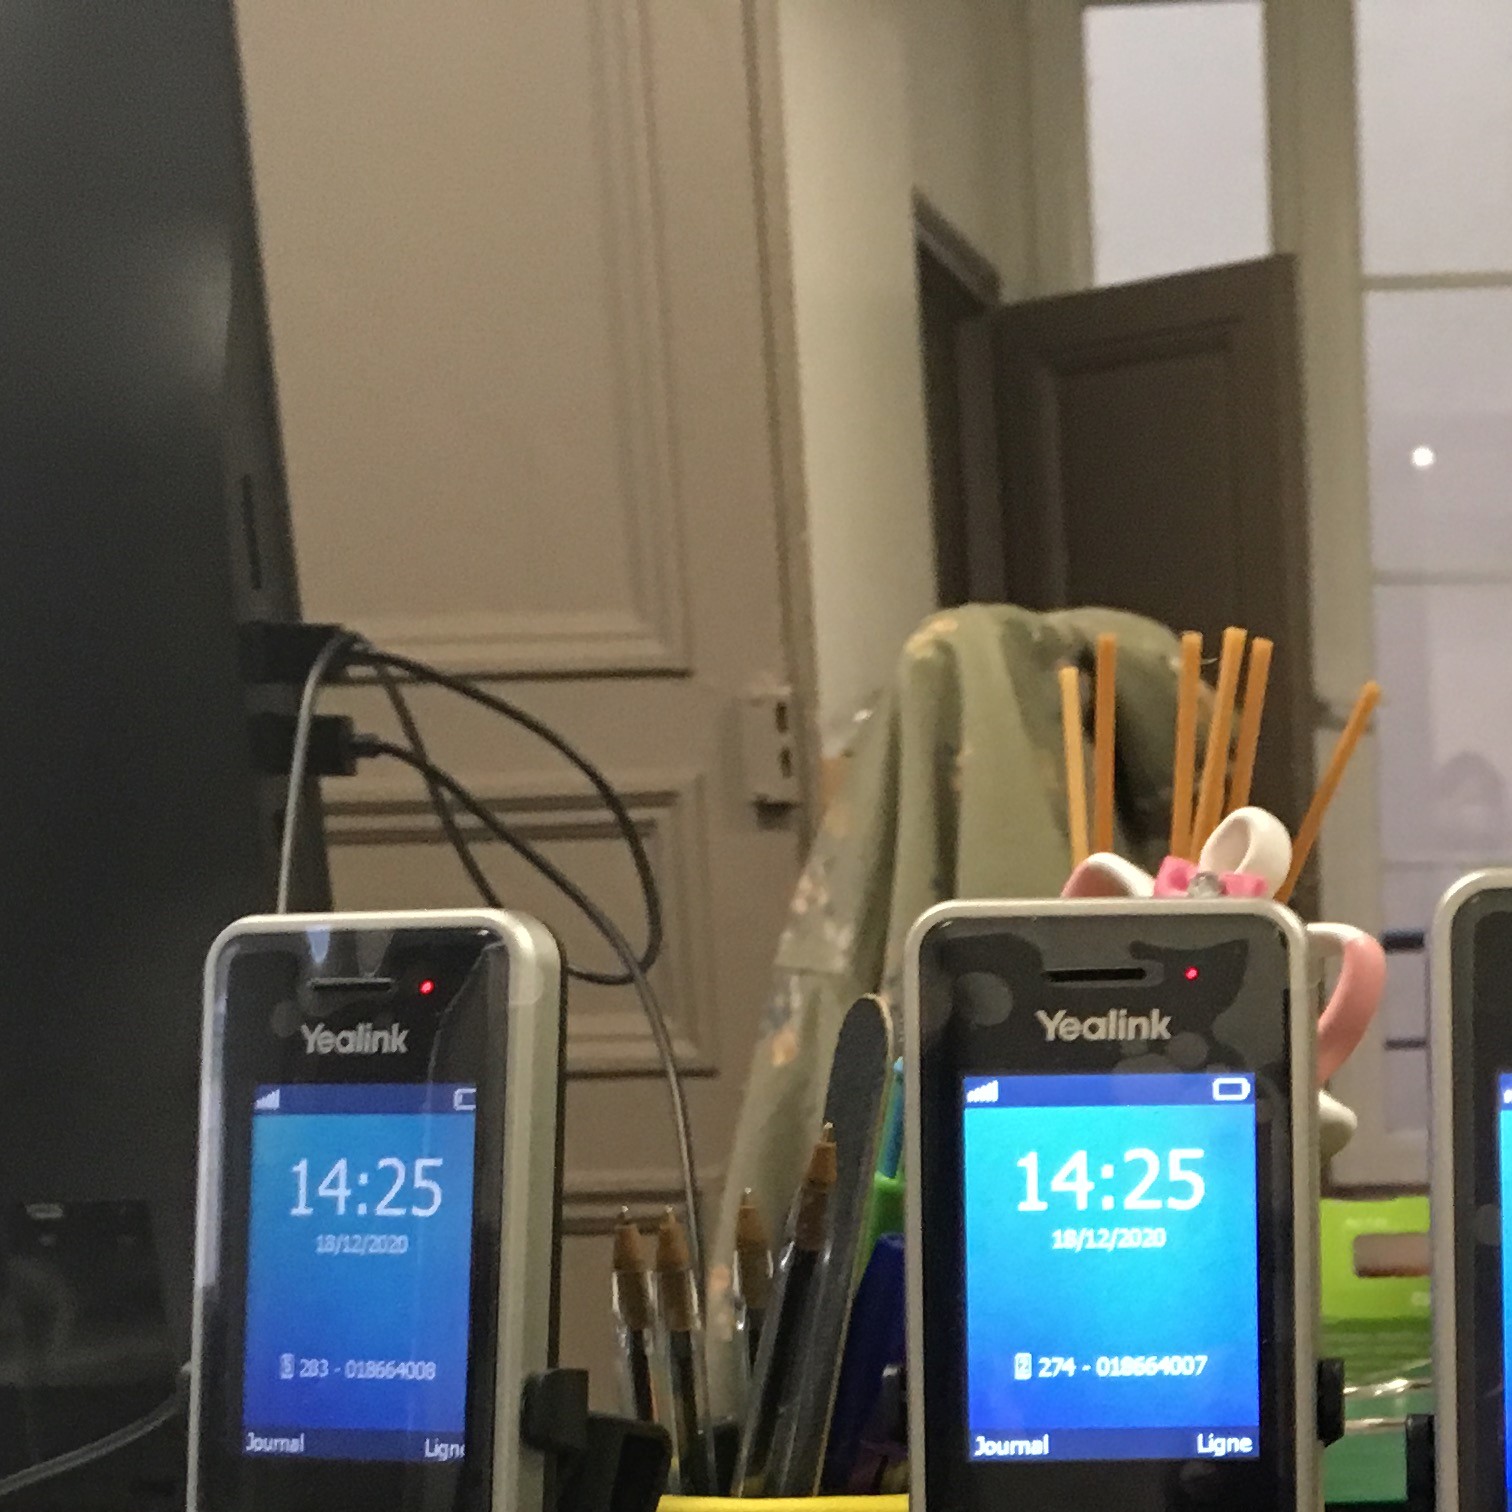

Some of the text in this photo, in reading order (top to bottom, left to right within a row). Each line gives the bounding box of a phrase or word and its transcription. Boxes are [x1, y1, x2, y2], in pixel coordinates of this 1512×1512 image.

[1036, 1009, 1172, 1042] Yealink
[301, 1023, 408, 1054] Yealink
[289, 1157, 444, 1217] 14:25
[1017, 1149, 1205, 1213] 14:25
[316, 1234, 408, 1255] 18/12/2020
[1052, 1228, 1166, 1252] 18/12/2020
[299, 1357, 329, 1379] 283
[1039, 1356, 1075, 1378] 274
[1096, 1355, 1208, 1378] 018664007
[245, 1432, 304, 1454] Journal
[974, 1435, 1049, 1456] Journal
[1197, 1434, 1252, 1455] Ligne
